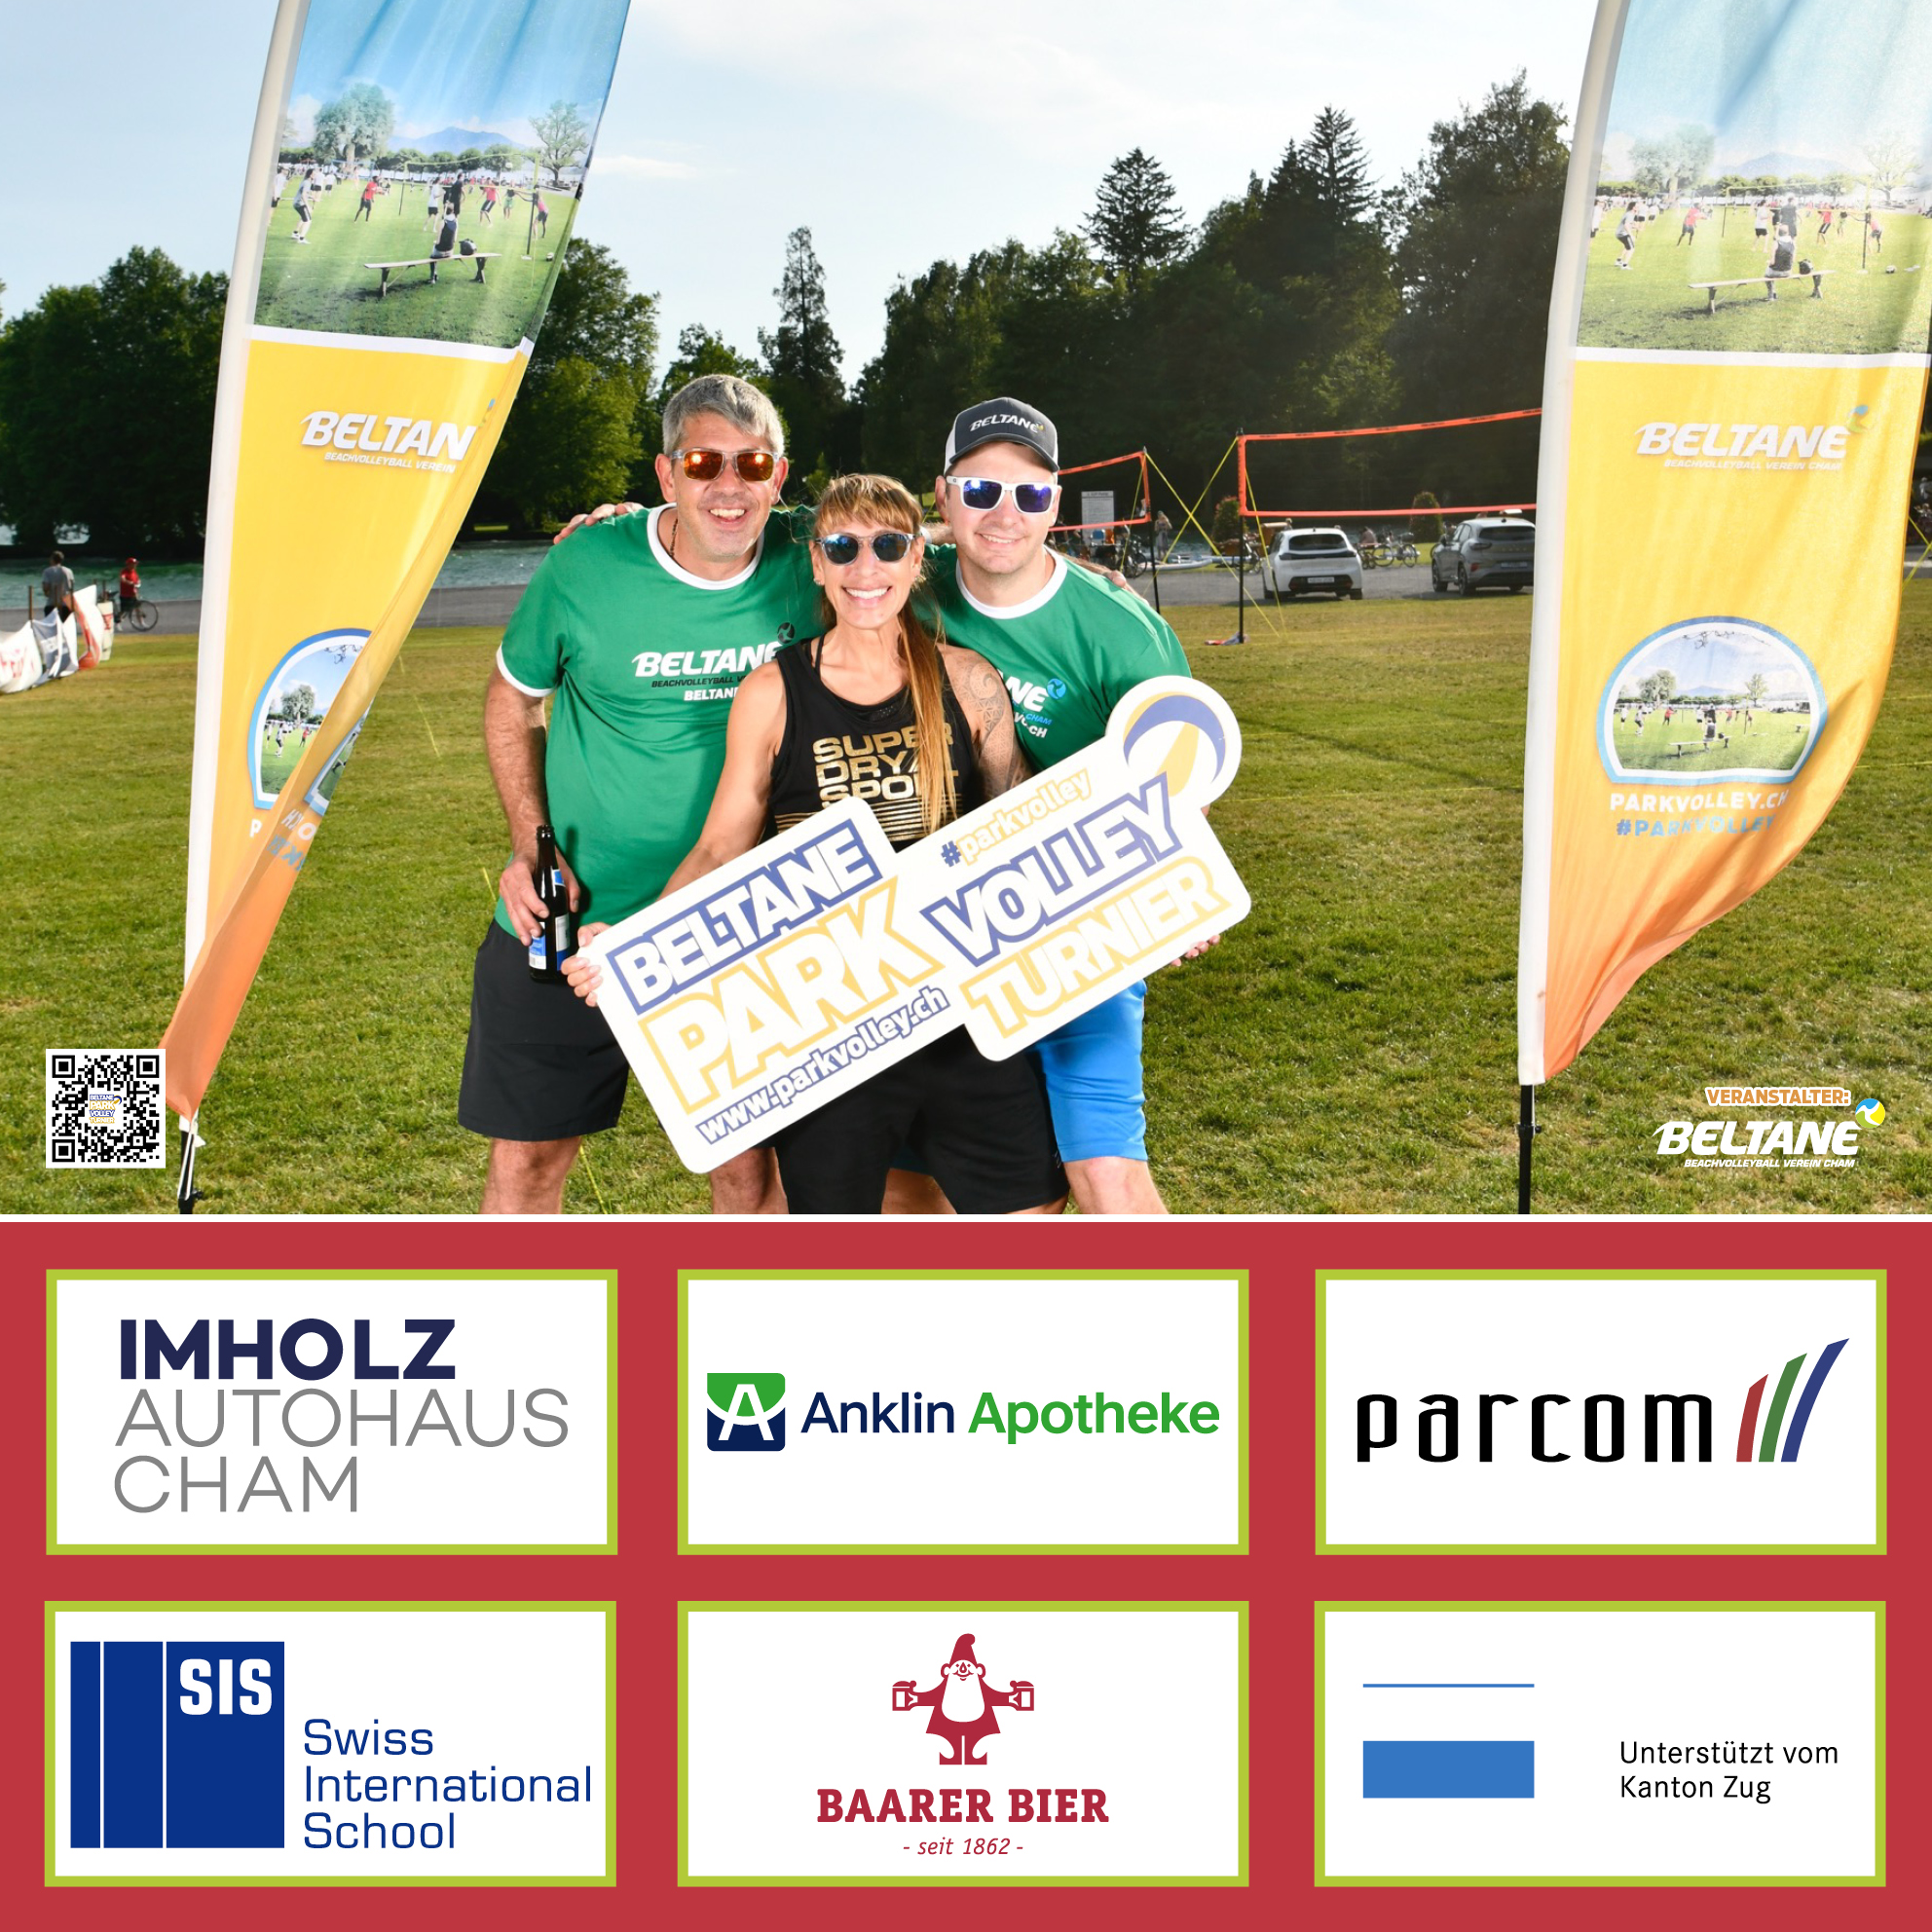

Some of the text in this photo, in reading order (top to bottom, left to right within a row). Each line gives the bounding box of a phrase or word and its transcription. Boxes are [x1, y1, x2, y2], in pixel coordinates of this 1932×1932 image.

[300, 410, 477, 462] BELTAN
[969, 413, 1040, 433] BELTANE
[1634, 422, 1851, 459] BELTANE
[324, 451, 457, 474] BEACHVOLLEYBALL VEREIN
[1663, 459, 1842, 470] BEACHVOLLEYBALL VEREIN CHAM
[651, 676, 734, 688] BEACHVOLLEYBALL
[1025, 713, 1052, 725] CHAM
[941, 767, 1092, 868] #parkvolley
[1610, 789, 1790, 813] PARKVOLLEY.CH
[1616, 813, 1775, 837] #PARKVOLLEY
[919, 771, 1183, 968] VOLLEY
[605, 818, 883, 1016] BELTANE
[958, 855, 1232, 1039] TURNIER
[638, 874, 947, 1115] PARK
[695, 985, 950, 1144] www.parkvolley.ch
